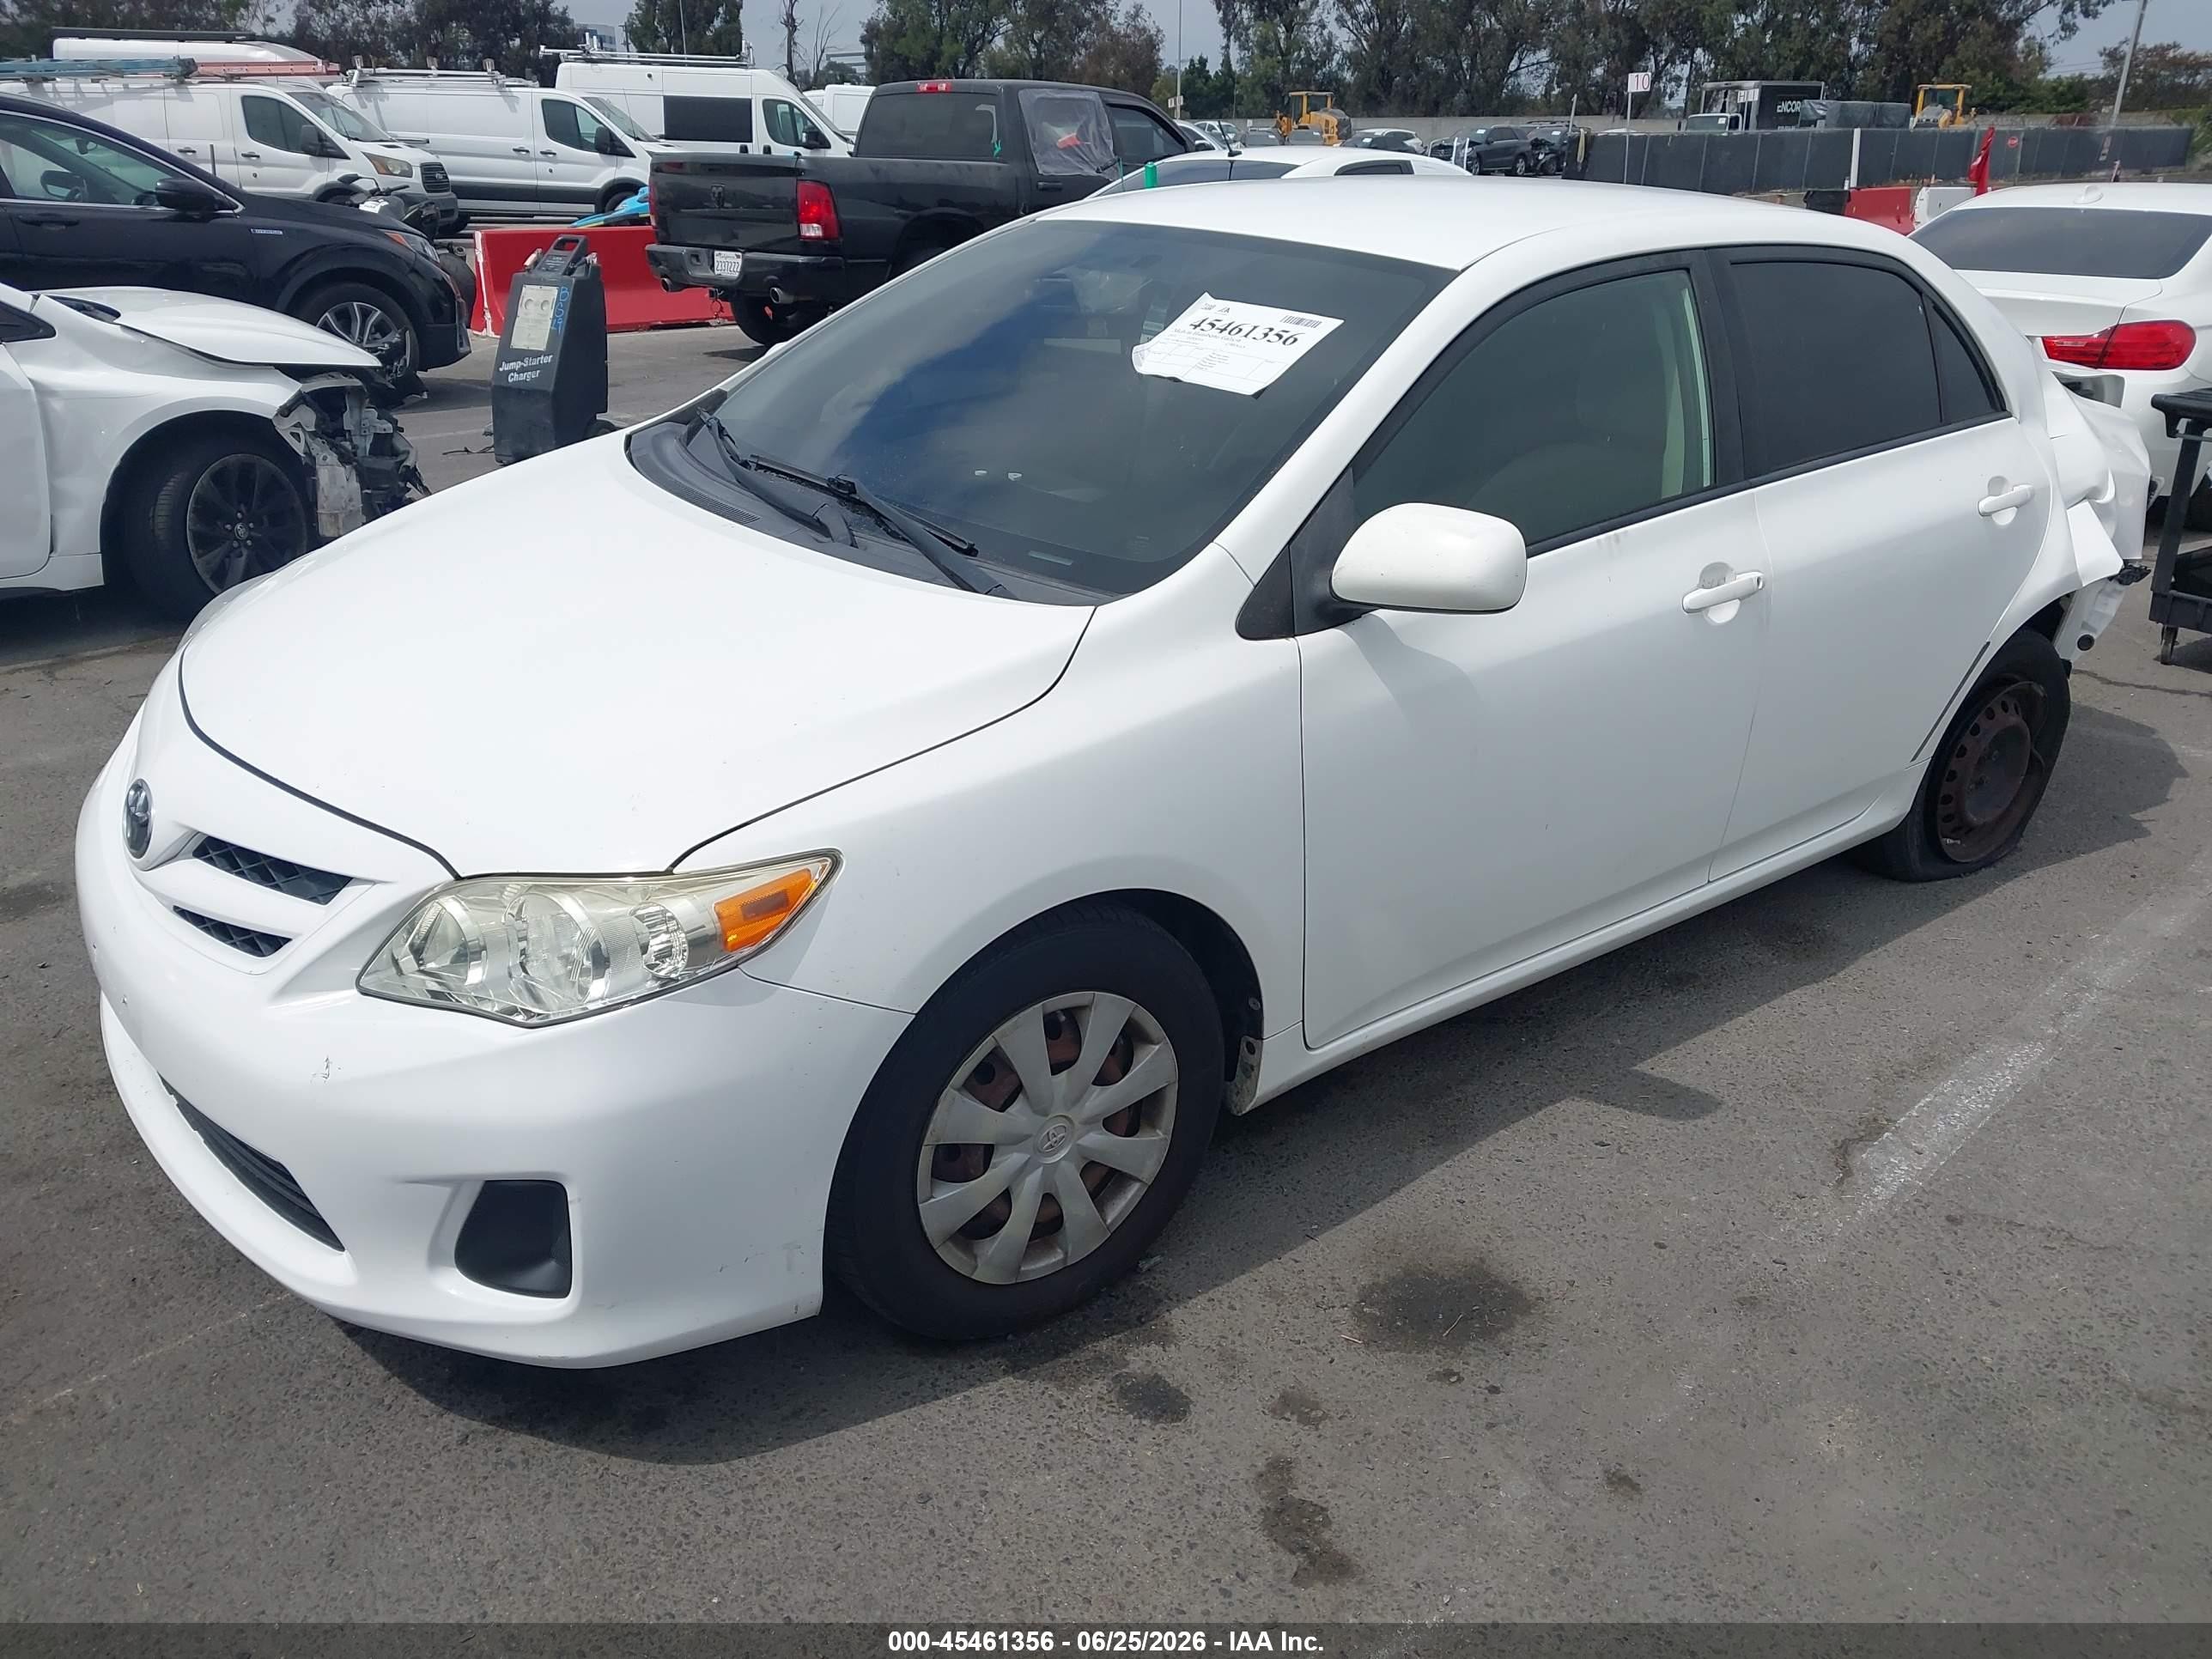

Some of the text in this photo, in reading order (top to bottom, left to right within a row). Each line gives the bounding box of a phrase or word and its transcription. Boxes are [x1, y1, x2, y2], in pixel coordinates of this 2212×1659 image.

[1635, 74, 1650, 90] 10
[1188, 317, 1305, 346] 45461356
[498, 354, 554, 372] Jump-Starter
[507, 369, 541, 383] Charger
